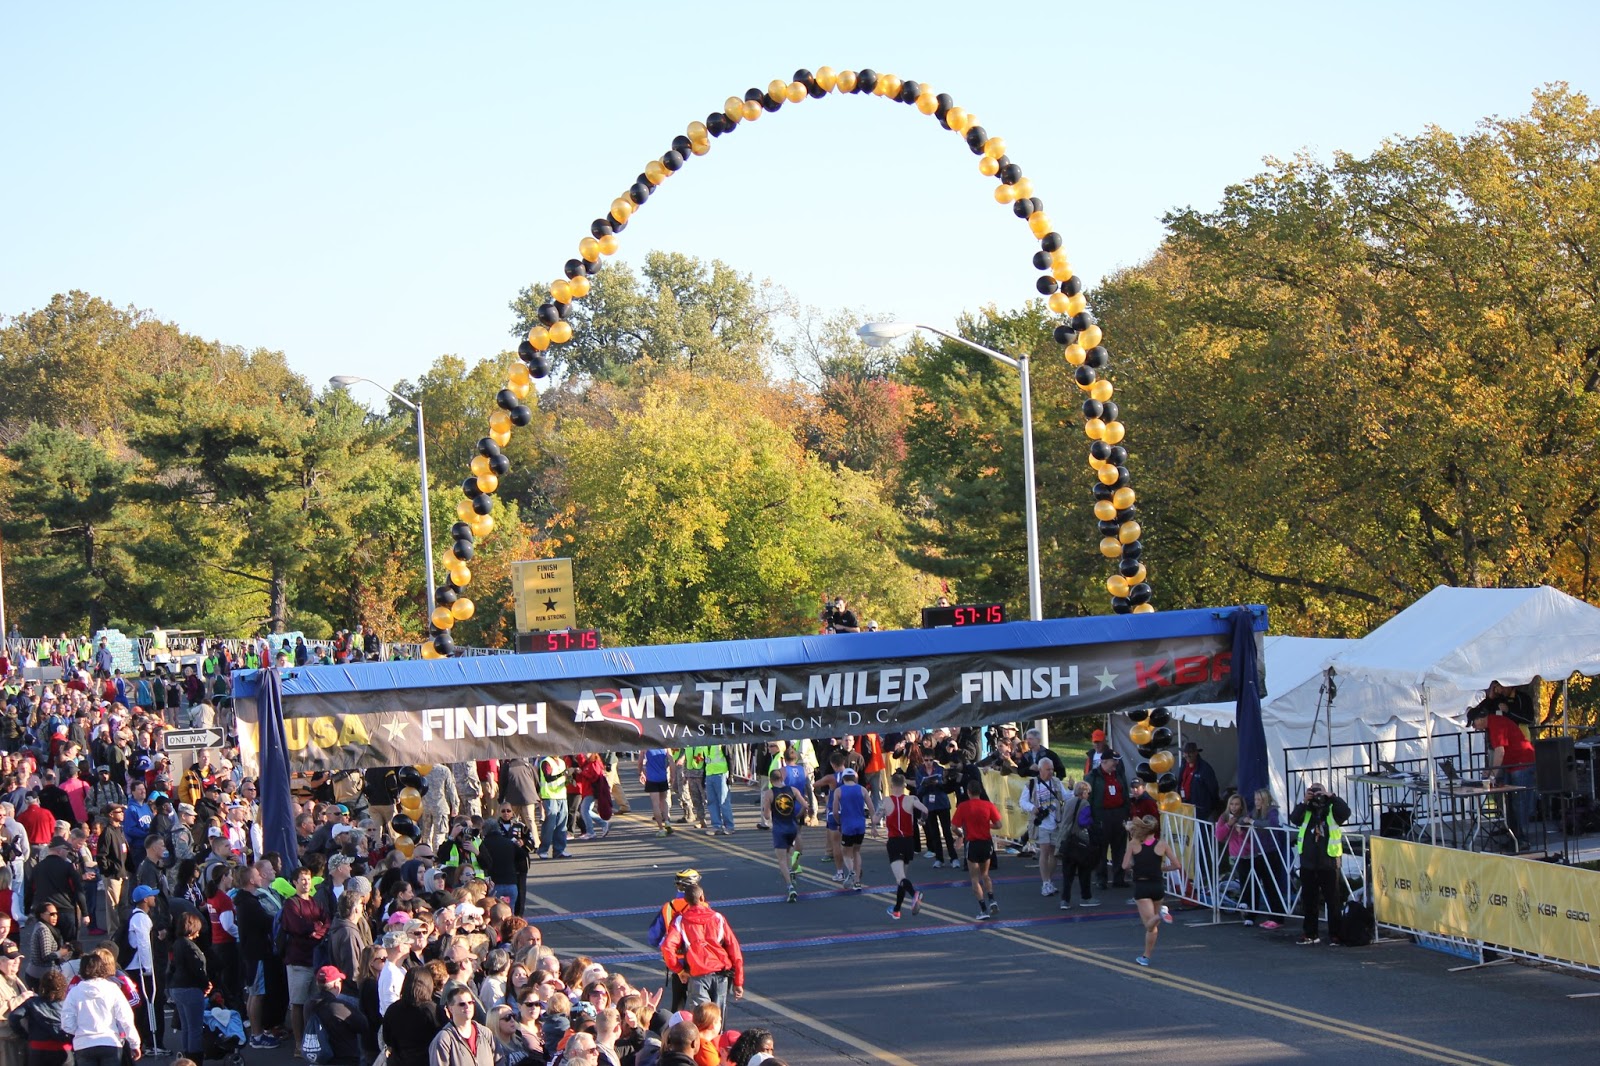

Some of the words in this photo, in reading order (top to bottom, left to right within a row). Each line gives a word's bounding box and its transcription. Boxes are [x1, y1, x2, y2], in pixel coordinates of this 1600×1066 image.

[537, 564, 557, 572] FINISH
[541, 572, 555, 580] LINE
[961, 665, 1080, 704] FINISH
[574, 684, 682, 737] ARMY
[696, 666, 930, 716] TEN-MILER
[422, 701, 548, 742] FINISH
[848, 708, 898, 727] D.C.
[252, 713, 371, 752] USA
[1394, 877, 1412, 891] KBR
[1438, 885, 1457, 899] KBR
[1488, 893, 1508, 907] KBR
[1537, 902, 1558, 918] KBR
